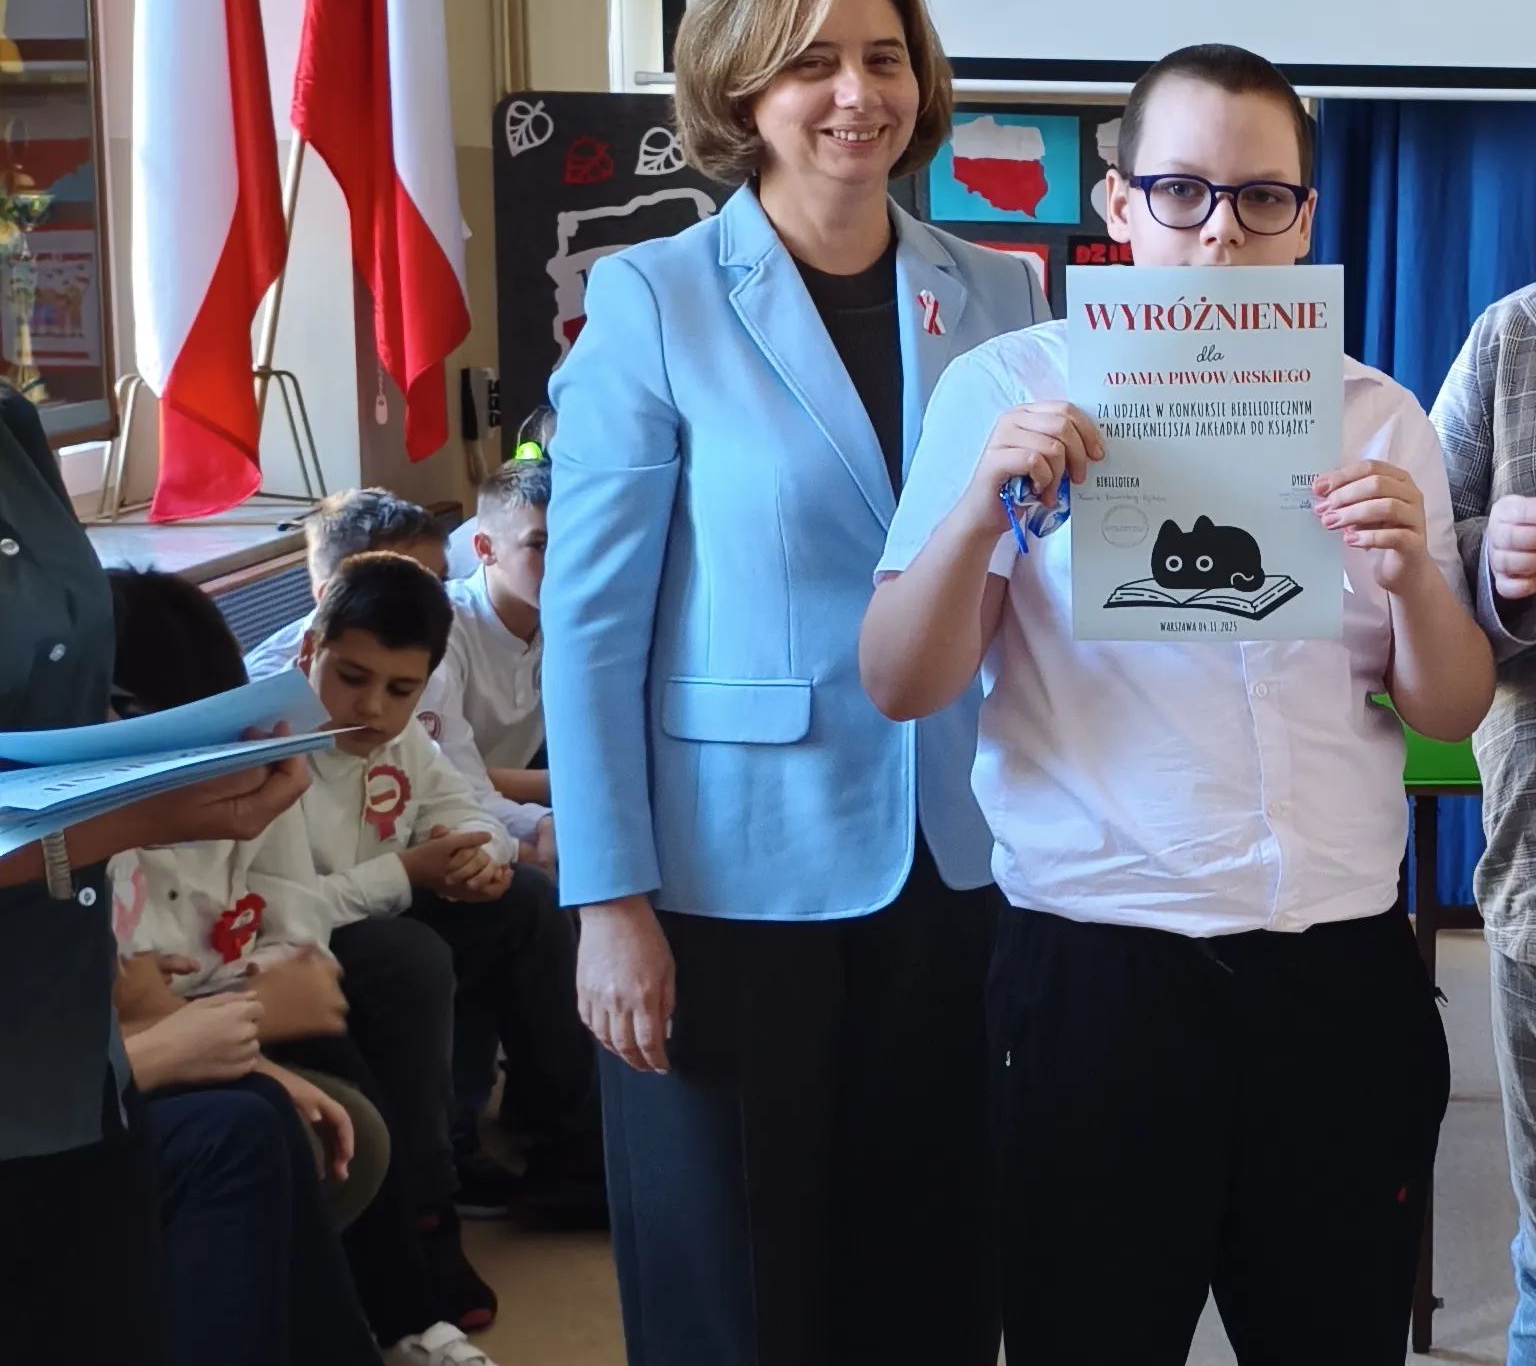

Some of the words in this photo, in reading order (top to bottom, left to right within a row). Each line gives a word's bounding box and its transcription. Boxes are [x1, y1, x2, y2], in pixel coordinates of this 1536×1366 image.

[1084, 296, 1328, 332] WYRÓŻNIENIE
[1196, 344, 1225, 363] dla
[1104, 371, 1165, 386] ADAMA
[1169, 368, 1312, 385] PIWOWARSKIEGO
[1098, 403, 1109, 419] ZA
[1114, 403, 1151, 418] UDZIAŁ
[1156, 403, 1164, 418] W
[1169, 402, 1226, 417] KONKURSIE
[1195, 420, 1247, 436] ZAKŁADKA
[1251, 420, 1264, 435] DO
[1160, 621, 1197, 632] WARSZAWA
